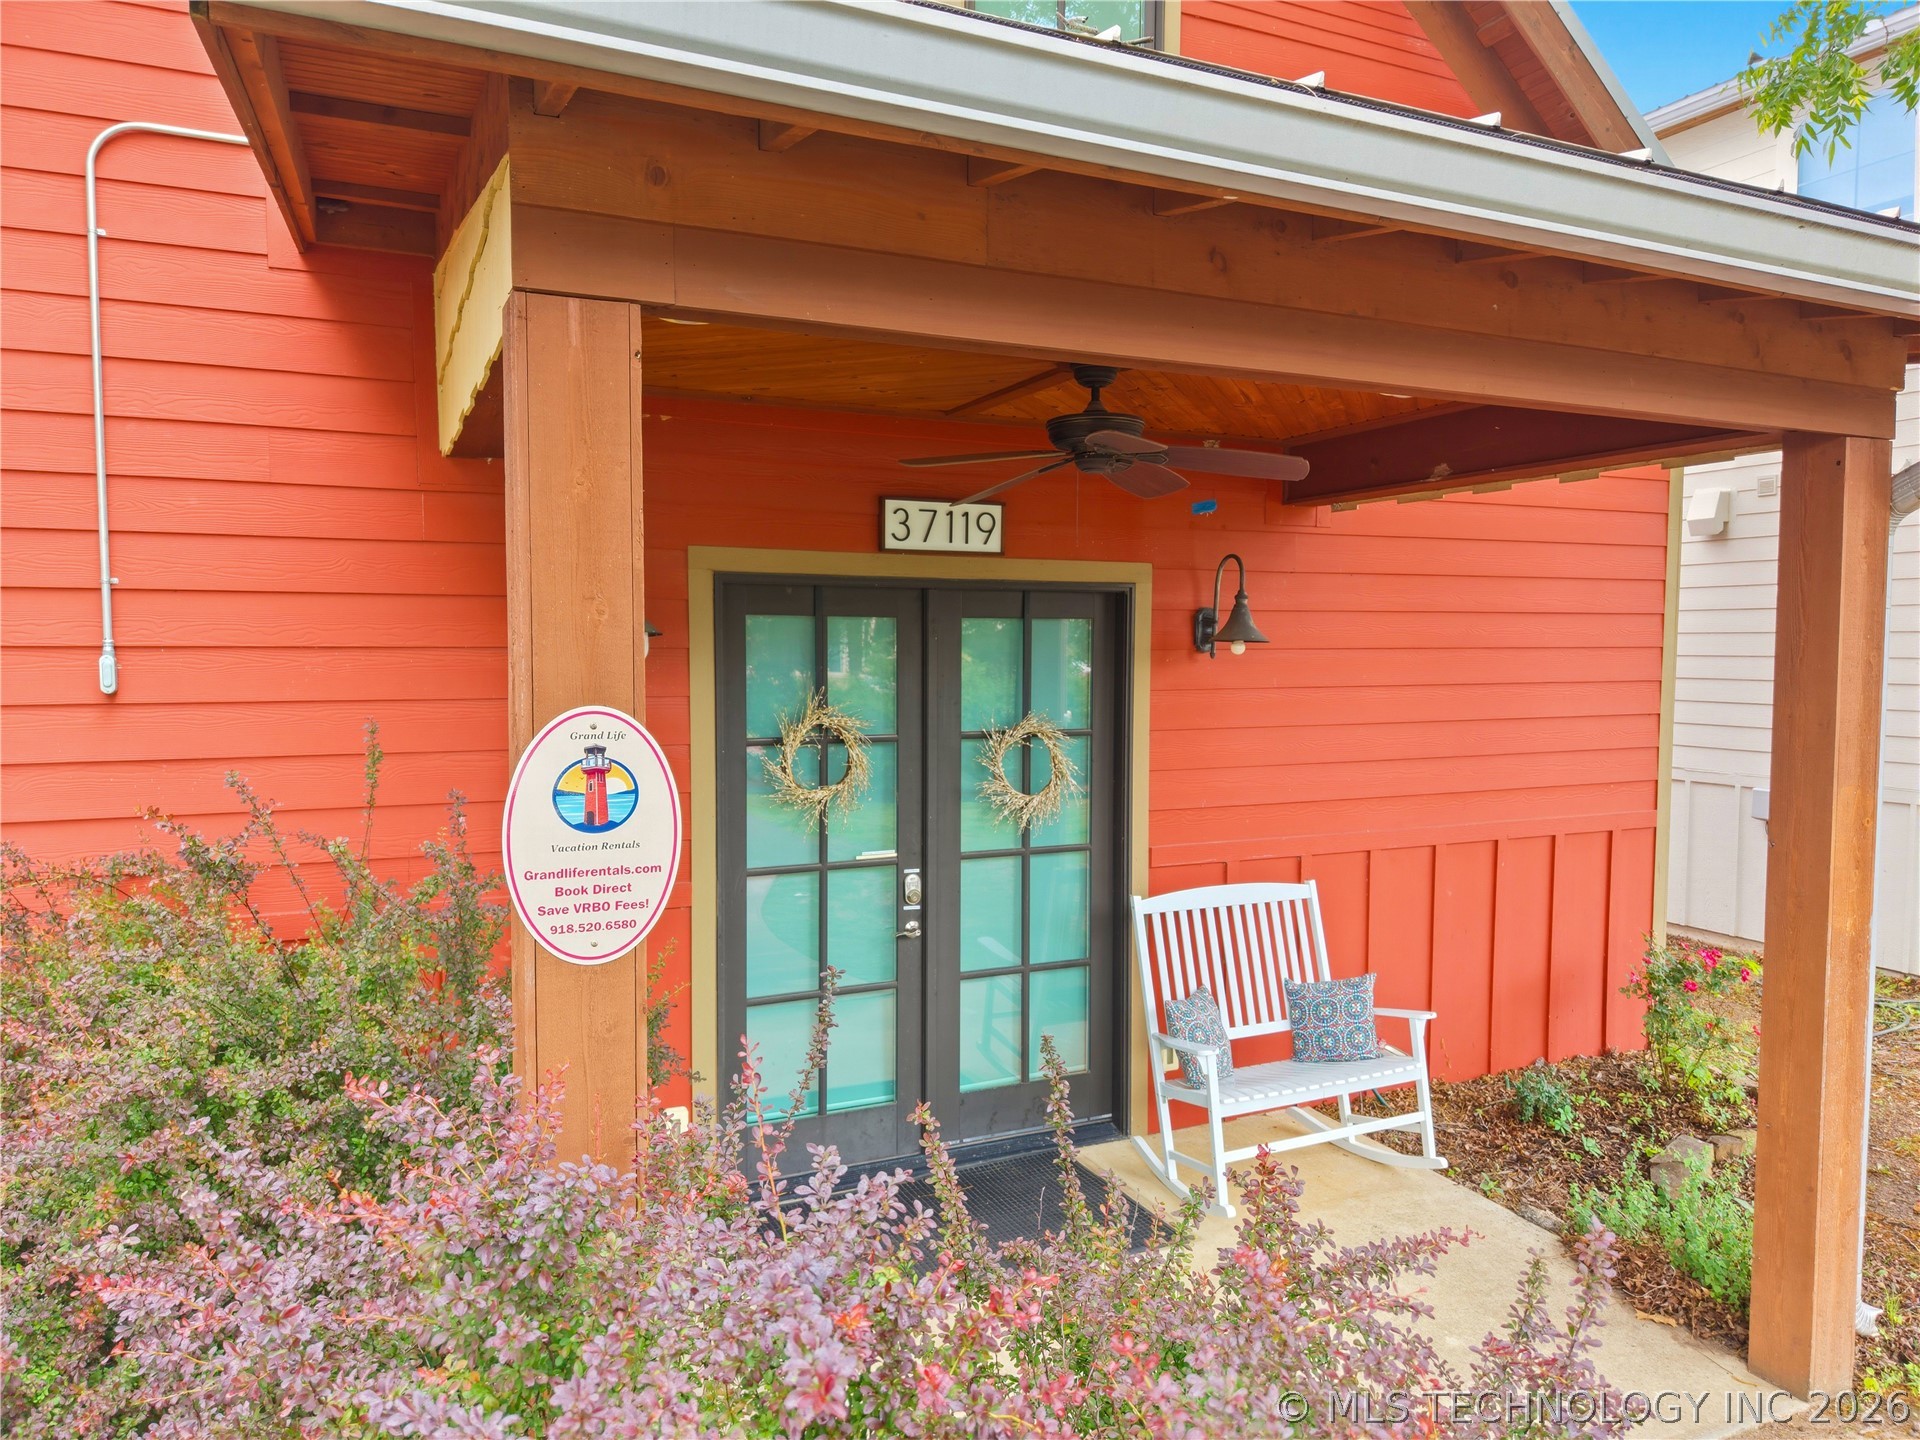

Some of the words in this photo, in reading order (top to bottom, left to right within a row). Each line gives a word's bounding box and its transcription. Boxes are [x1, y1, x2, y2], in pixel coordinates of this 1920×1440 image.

[891, 508, 996, 545] 37119
[570, 731, 604, 741] Grand
[606, 731, 627, 741] Life
[551, 843, 598, 853] Vacation
[601, 840, 641, 851] Rentals
[524, 864, 662, 881] Grandliferentals.com
[554, 885, 589, 897] Book
[593, 882, 632, 895] Direct
[537, 905, 569, 916] Save
[574, 902, 610, 913] VRBO
[615, 898, 649, 911] Fees!
[550, 919, 637, 935] 918.520.6580
